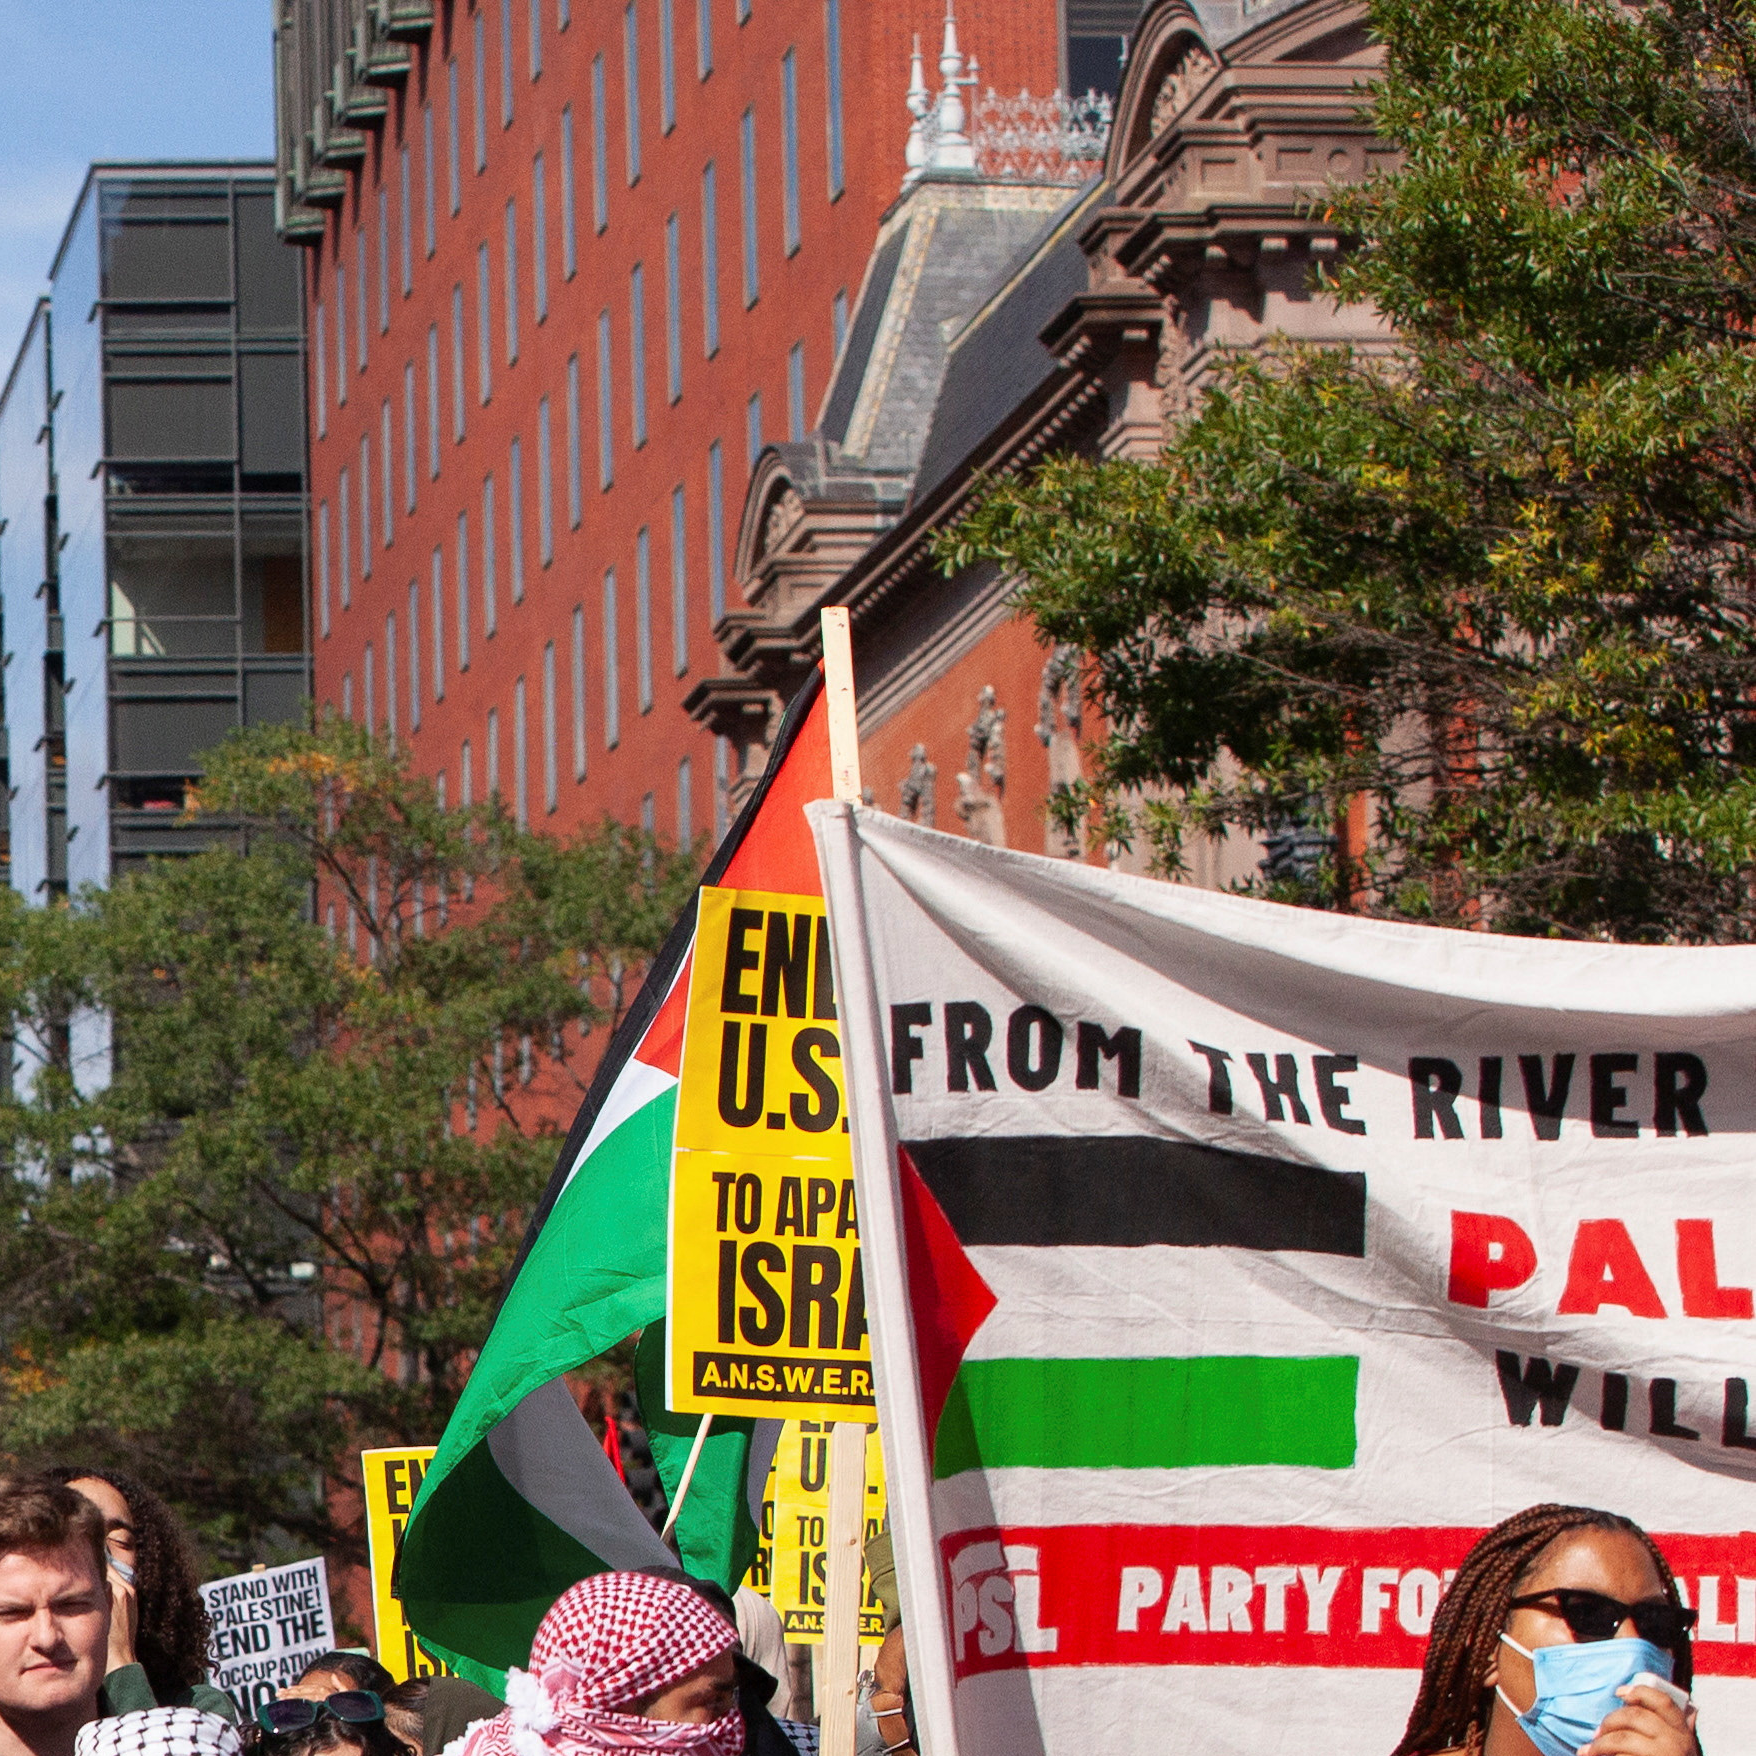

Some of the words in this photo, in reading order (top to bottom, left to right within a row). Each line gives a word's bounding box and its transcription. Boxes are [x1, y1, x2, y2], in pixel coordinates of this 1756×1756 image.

[891, 1001, 1143, 1100] FROM
[1187, 1039, 1369, 1137] THE
[1407, 1051, 1709, 1142] RIVER
[712, 1172, 762, 1235] TO
[1446, 1209, 1756, 1321] PAL
[700, 1360, 875, 1397] A.N.S.W.E.R.
[797, 1516, 824, 1547] TO
[209, 1578, 268, 1609] STAND
[272, 1566, 319, 1594] WITH
[212, 1587, 322, 1631] PALESTINE!
[1117, 1563, 1345, 1636] PARTY
[1361, 1566, 1456, 1637] FO
[215, 1623, 271, 1660] END
[276, 1609, 327, 1647] THE
[951, 1574, 1060, 1663] PSL
